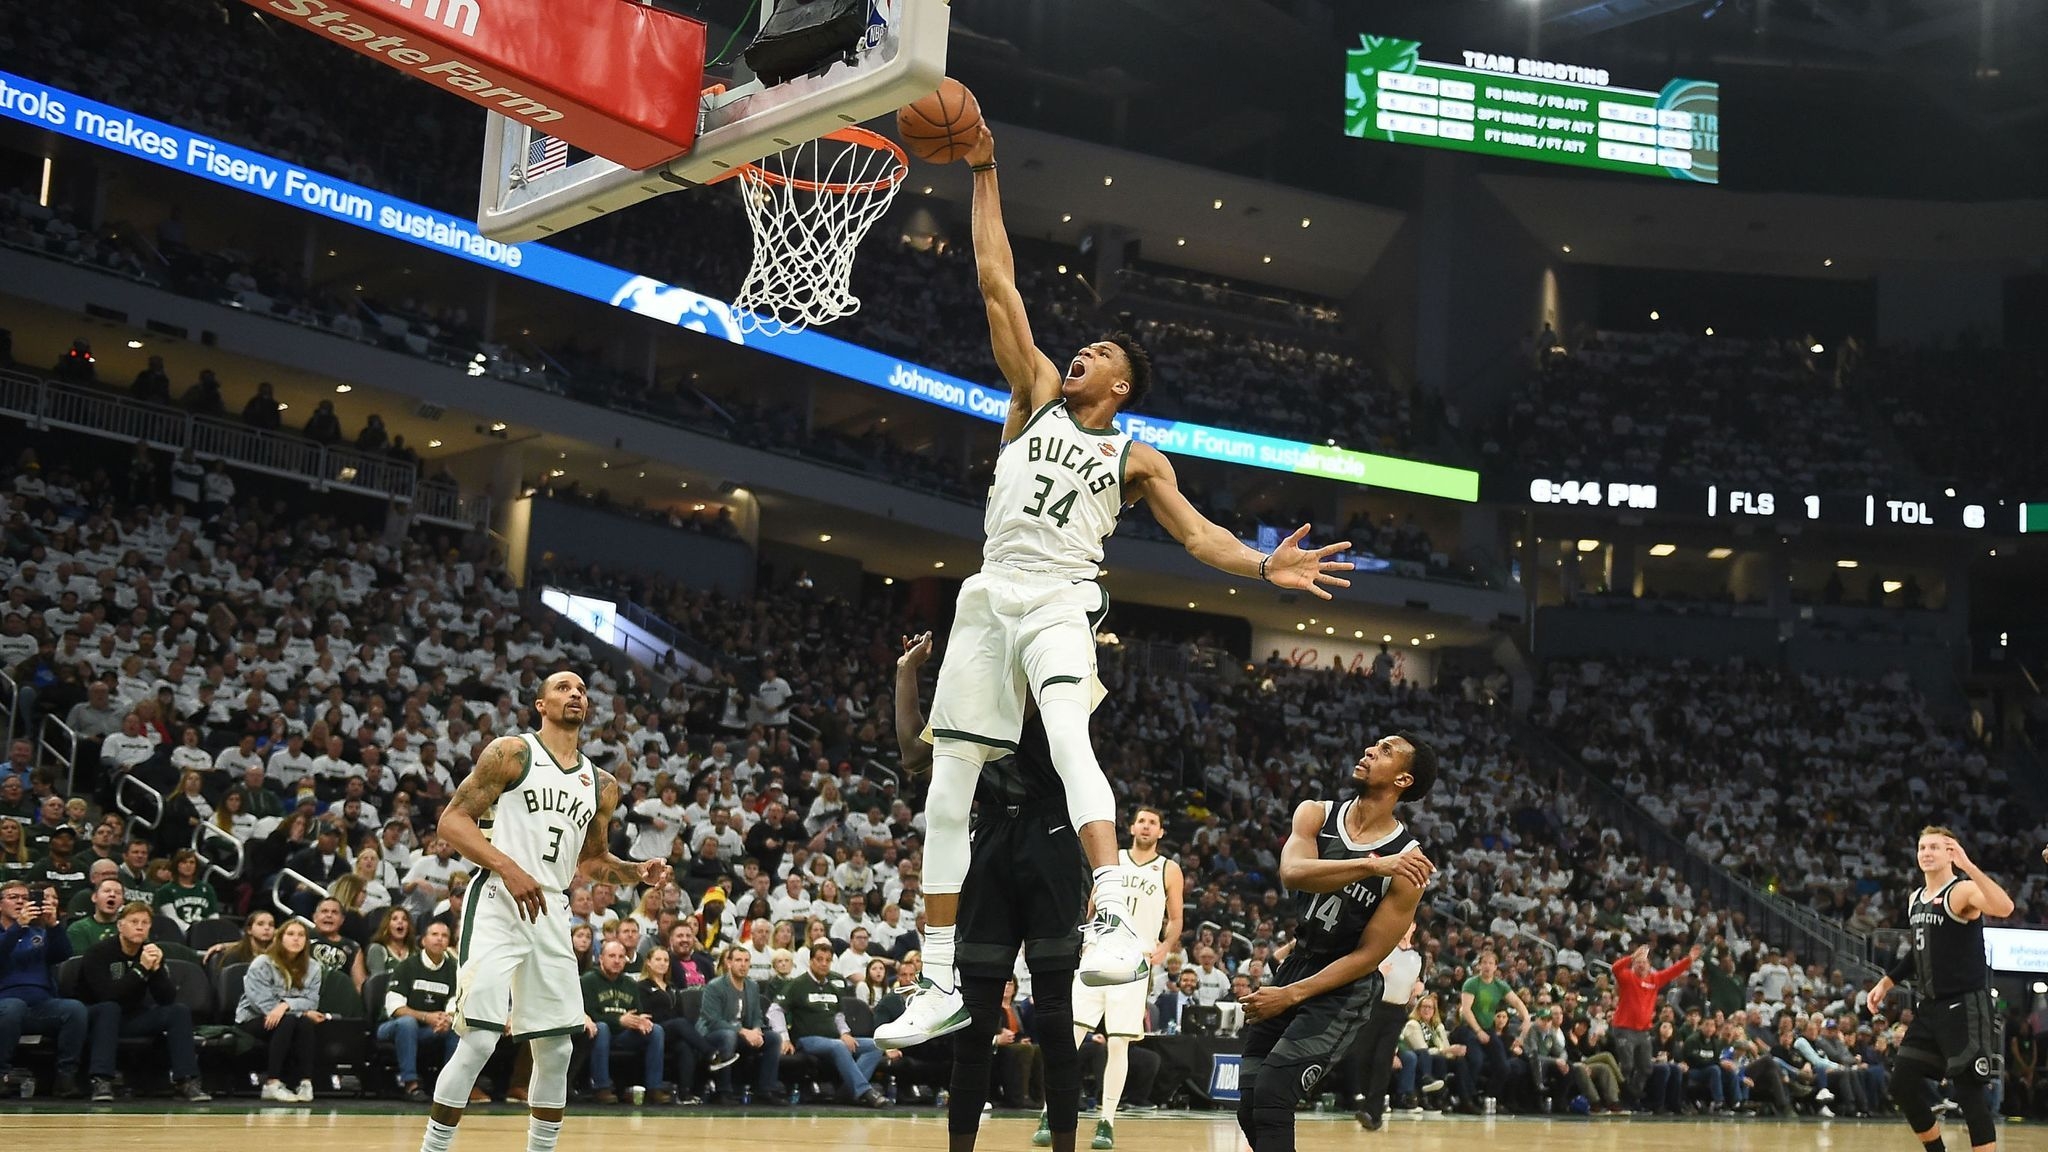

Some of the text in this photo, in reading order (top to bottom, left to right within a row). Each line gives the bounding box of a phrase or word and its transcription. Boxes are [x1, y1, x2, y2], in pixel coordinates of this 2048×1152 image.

[1462, 50, 1609, 86] TEAM SHOOTING
[75, 109, 178, 160] makes
[186, 138, 278, 190] Fiserv
[284, 169, 373, 222] Forum
[379, 205, 523, 268] sustainable
[888, 364, 966, 406] Johnson
[1028, 436, 1117, 495] BUCKS
[1126, 418, 1188, 446] Fiserv
[1192, 430, 1256, 461] Forum
[1259, 444, 1366, 478] sustainable
[1022, 473, 1079, 528] 34
[1608, 482, 1658, 509] PM
[1730, 491, 1820, 519] FLS 1
[1886, 500, 1934, 525] TOL
[523, 787, 593, 831] BUCKS
[541, 826, 564, 864] 3
[1121, 875, 1157, 896] UCKS
[1343, 881, 1377, 908] CITY
[1304, 892, 1342, 932] 14
[1915, 928, 1925, 951] 5
[1215, 1063, 1240, 1091] NBA
